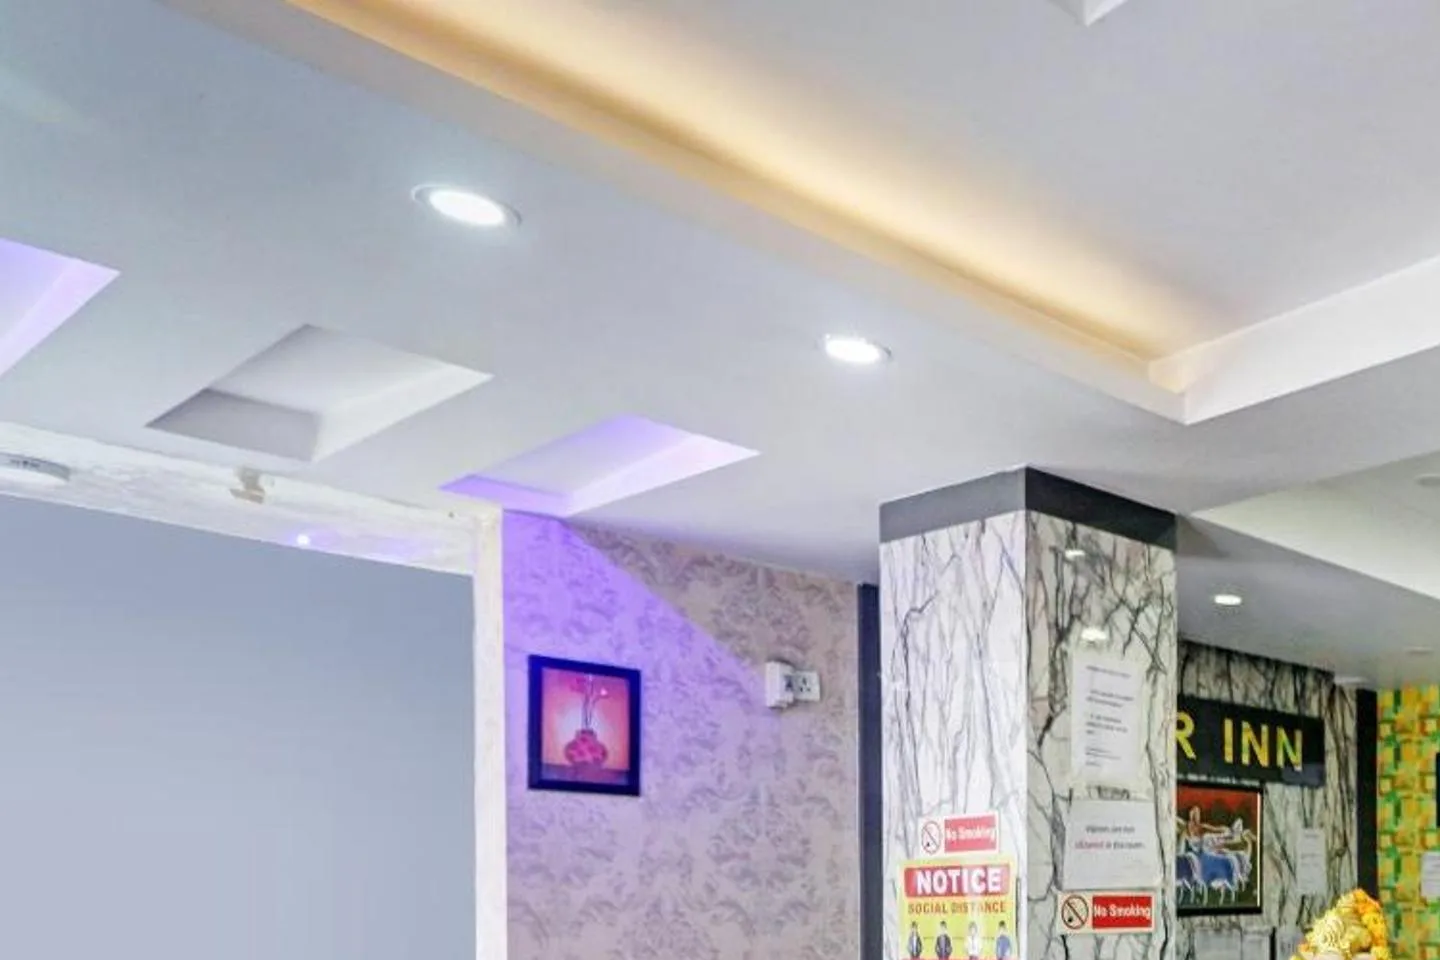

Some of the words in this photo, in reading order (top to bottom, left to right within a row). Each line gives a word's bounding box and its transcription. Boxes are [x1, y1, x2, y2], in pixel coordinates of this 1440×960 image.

[1224, 718, 1303, 771] INN
[946, 828, 957, 841] No
[957, 826, 996, 844] Smoking
[916, 867, 1002, 895] NOTICE
[908, 902, 948, 914] SOCIAL
[951, 901, 1007, 913] DISTANCE
[1094, 905, 1107, 917] No
[1109, 903, 1151, 920] Smoking
